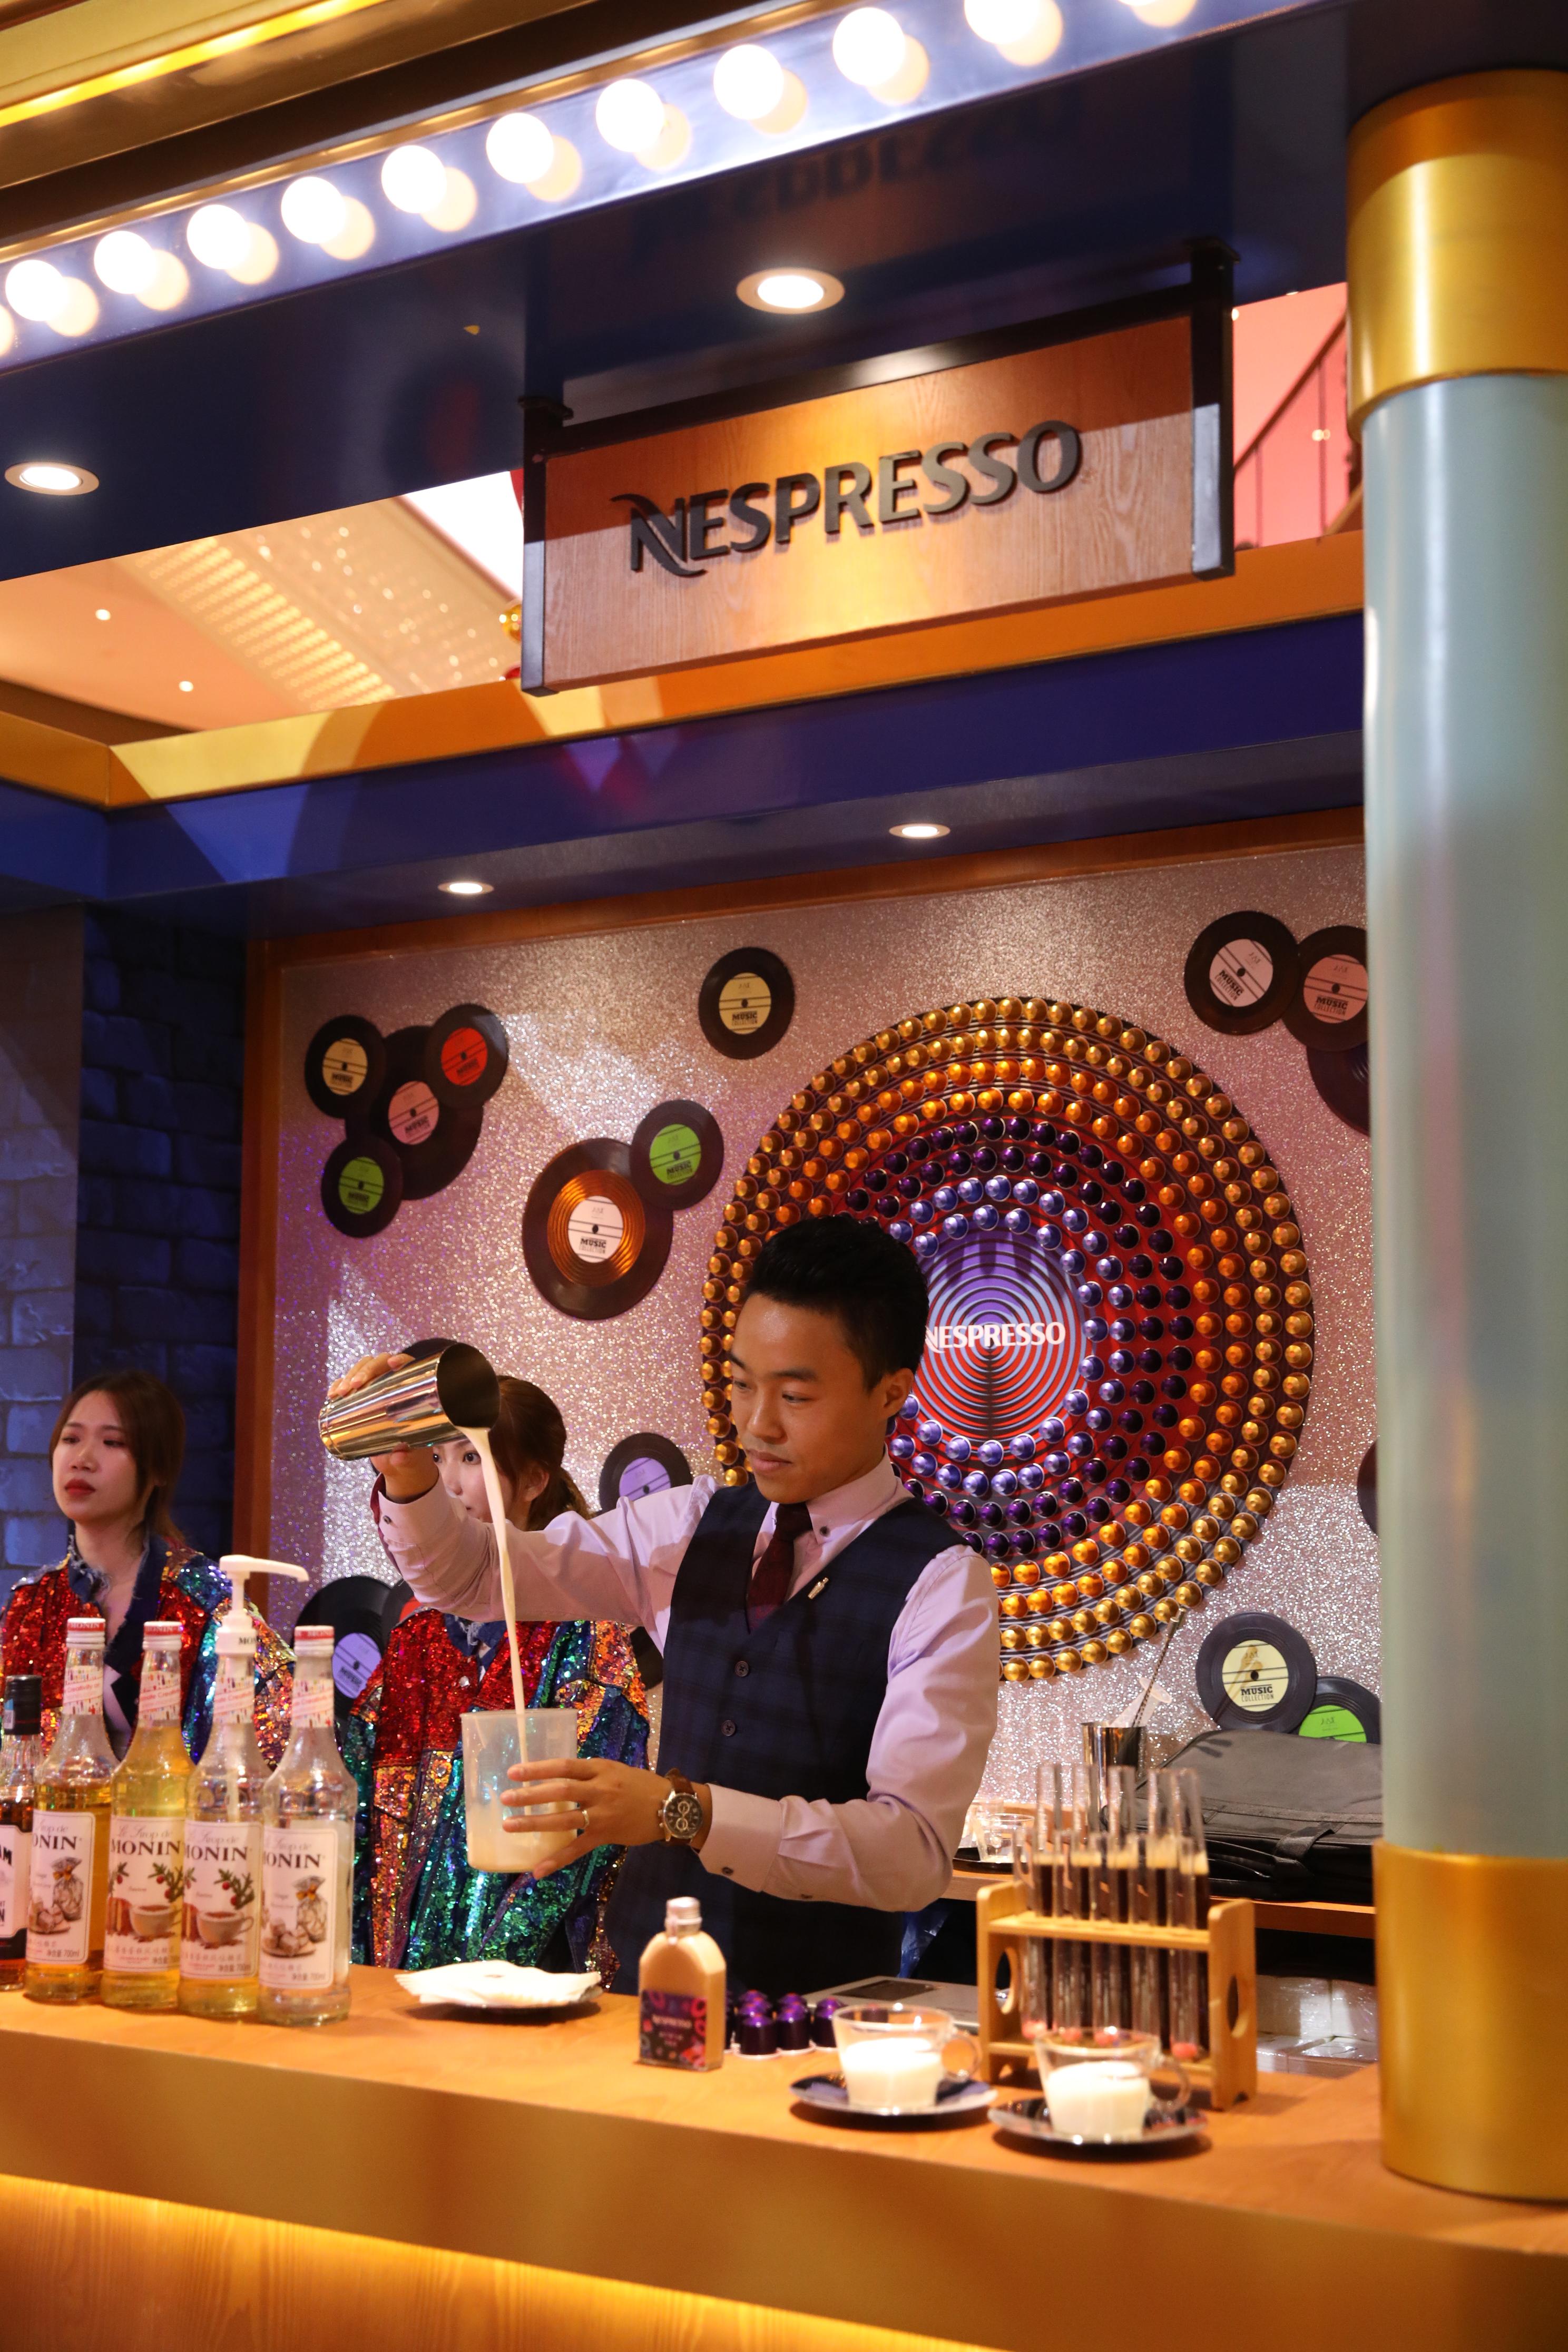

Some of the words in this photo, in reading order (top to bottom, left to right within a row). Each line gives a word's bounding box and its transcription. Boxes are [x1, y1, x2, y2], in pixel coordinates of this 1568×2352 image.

[611, 420, 1081, 577] NESPRESSO
[1219, 970, 1242, 996] MUSIC
[1317, 997, 1348, 1009] MUSIC
[732, 1011, 757, 1020] MUSIC
[667, 1161, 691, 1175] MUSIC
[581, 1238, 606, 1248] MUSIC
[925, 1321, 1066, 1354] NESPRESSO
[1241, 1686, 1273, 1696] MUSIC
[1242, 1694, 1274, 1702] COLLECTION
[111, 1839, 180, 1855] MONIN
